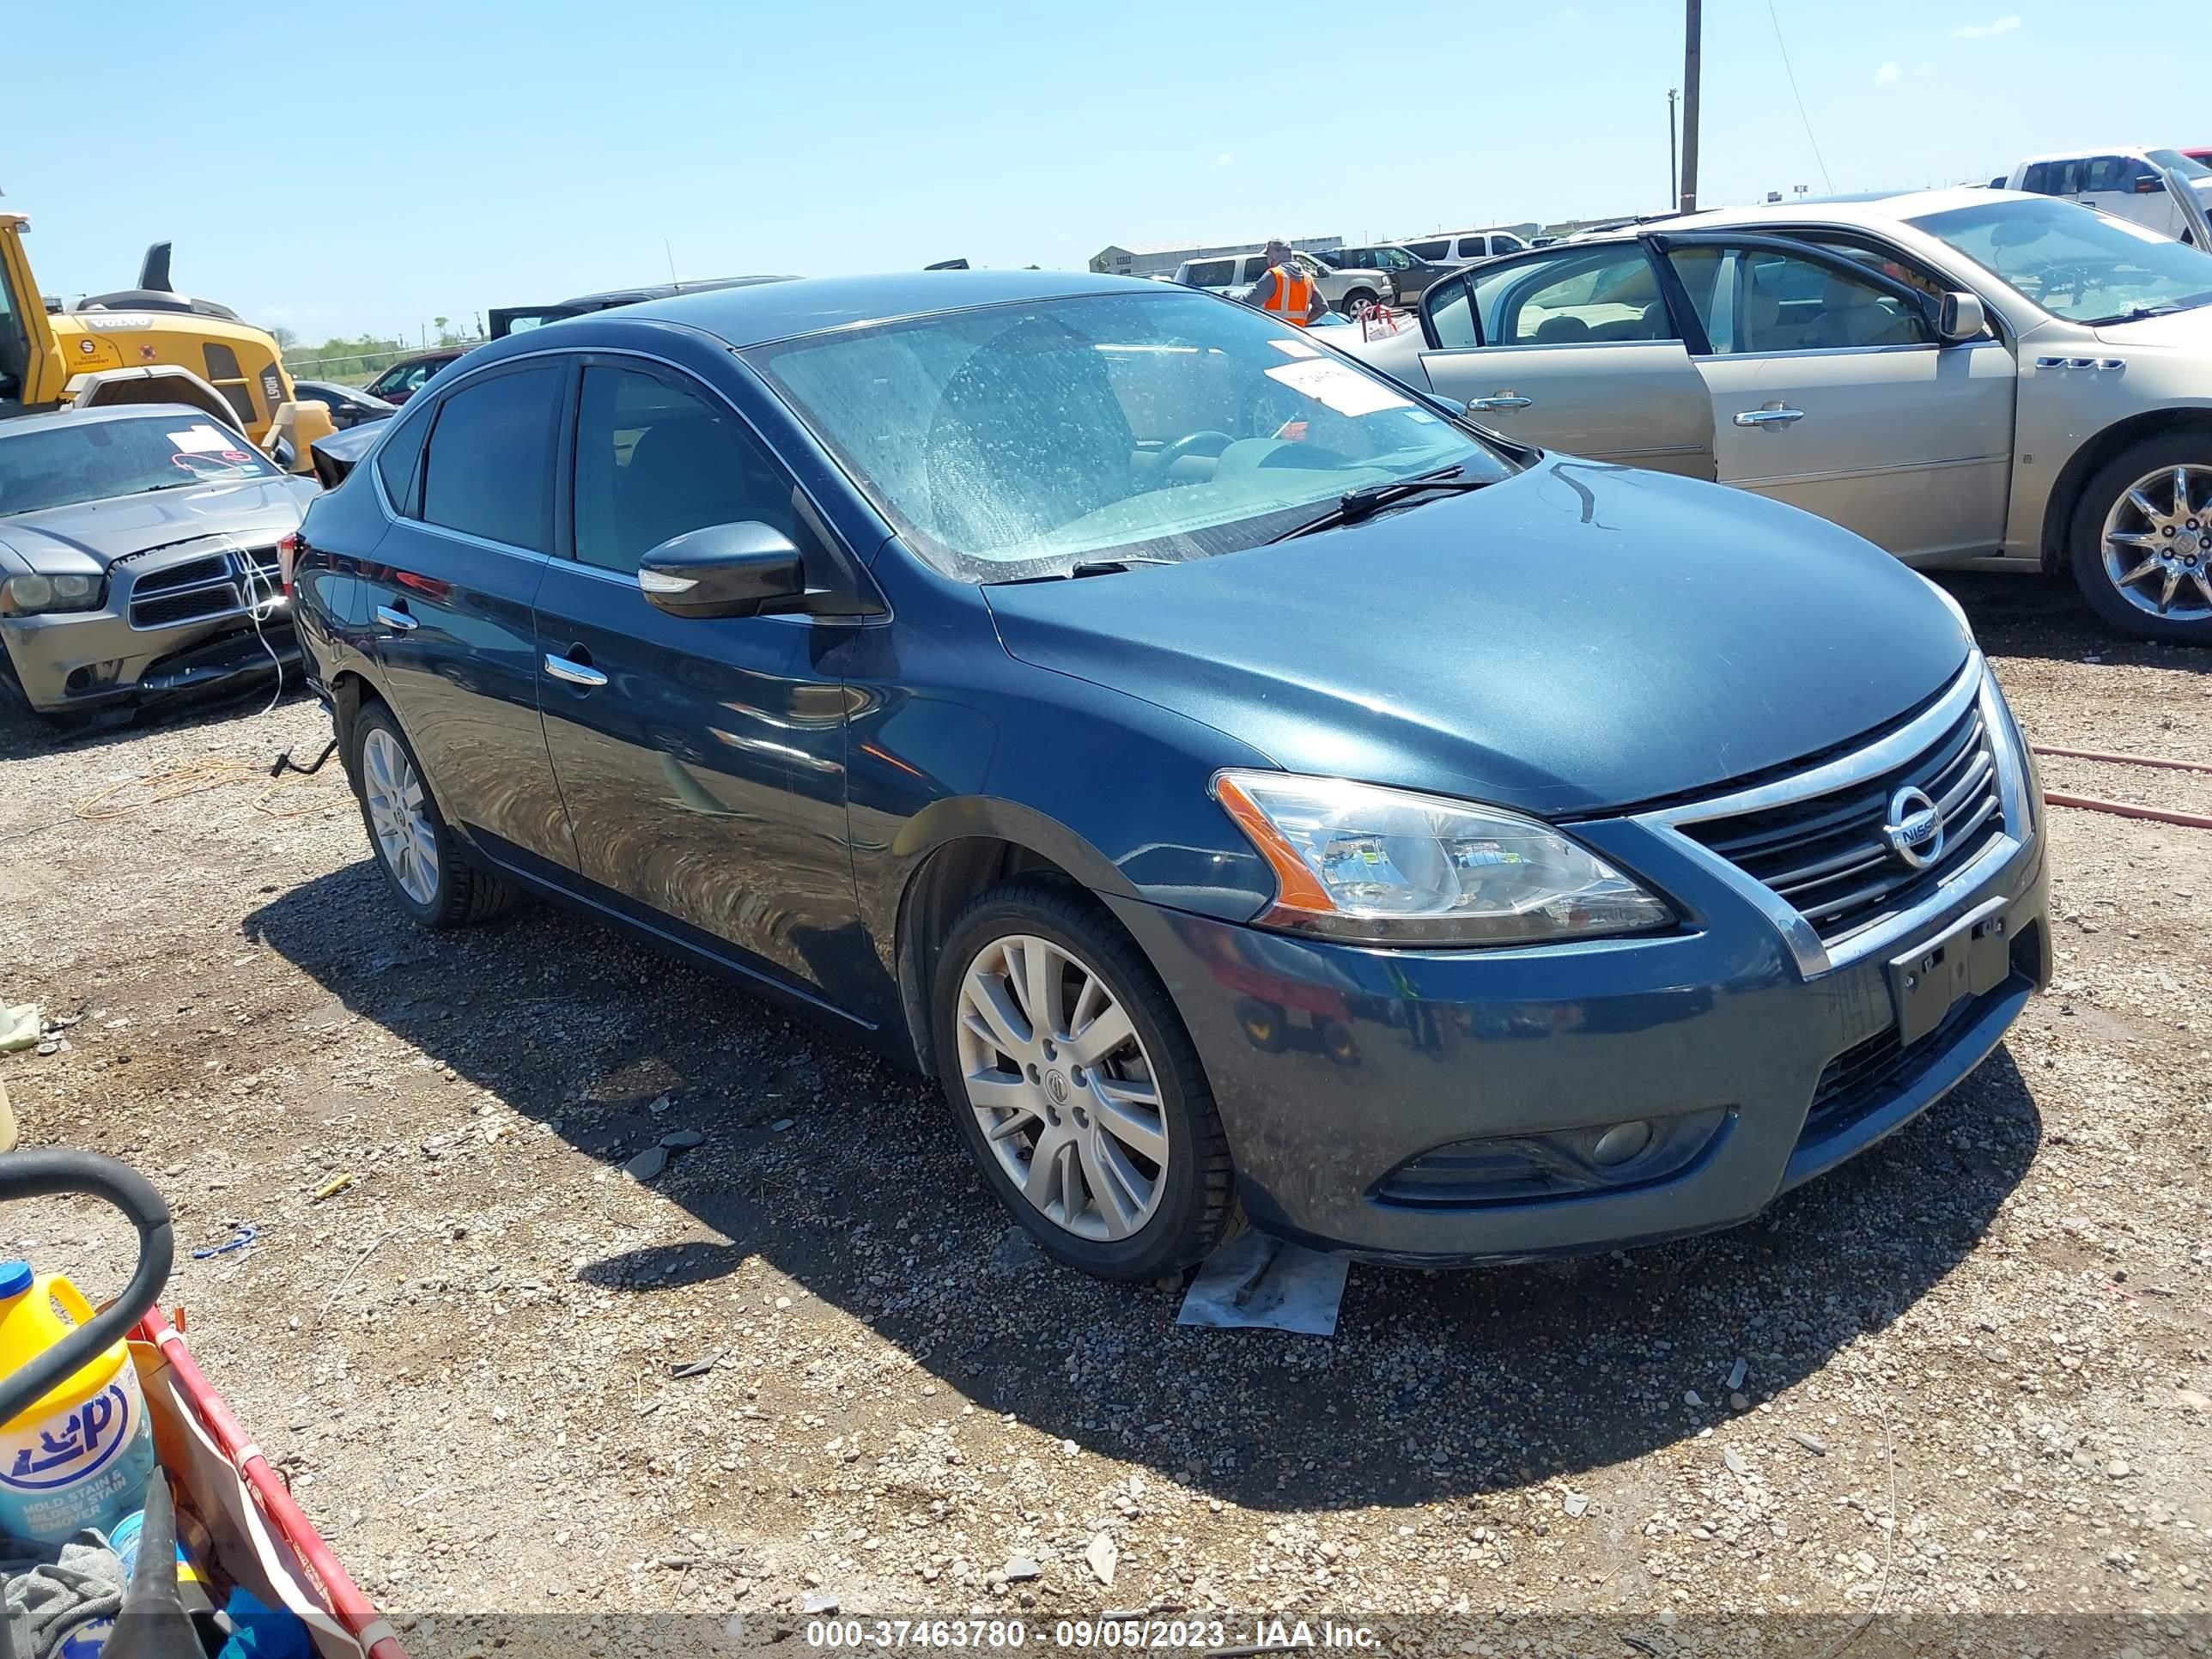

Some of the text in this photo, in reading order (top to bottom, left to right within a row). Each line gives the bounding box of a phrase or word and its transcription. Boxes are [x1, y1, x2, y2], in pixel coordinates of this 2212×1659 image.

[89, 317, 149, 328] VOLVO
[264, 376, 281, 399] L90H
[1903, 813, 1943, 843] NISSAN
[22, 1468, 122, 1514] MOLD STAIN &
[27, 1475, 126, 1523] MILDEW STAIN
[30, 1504, 100, 1534] REMOVER
